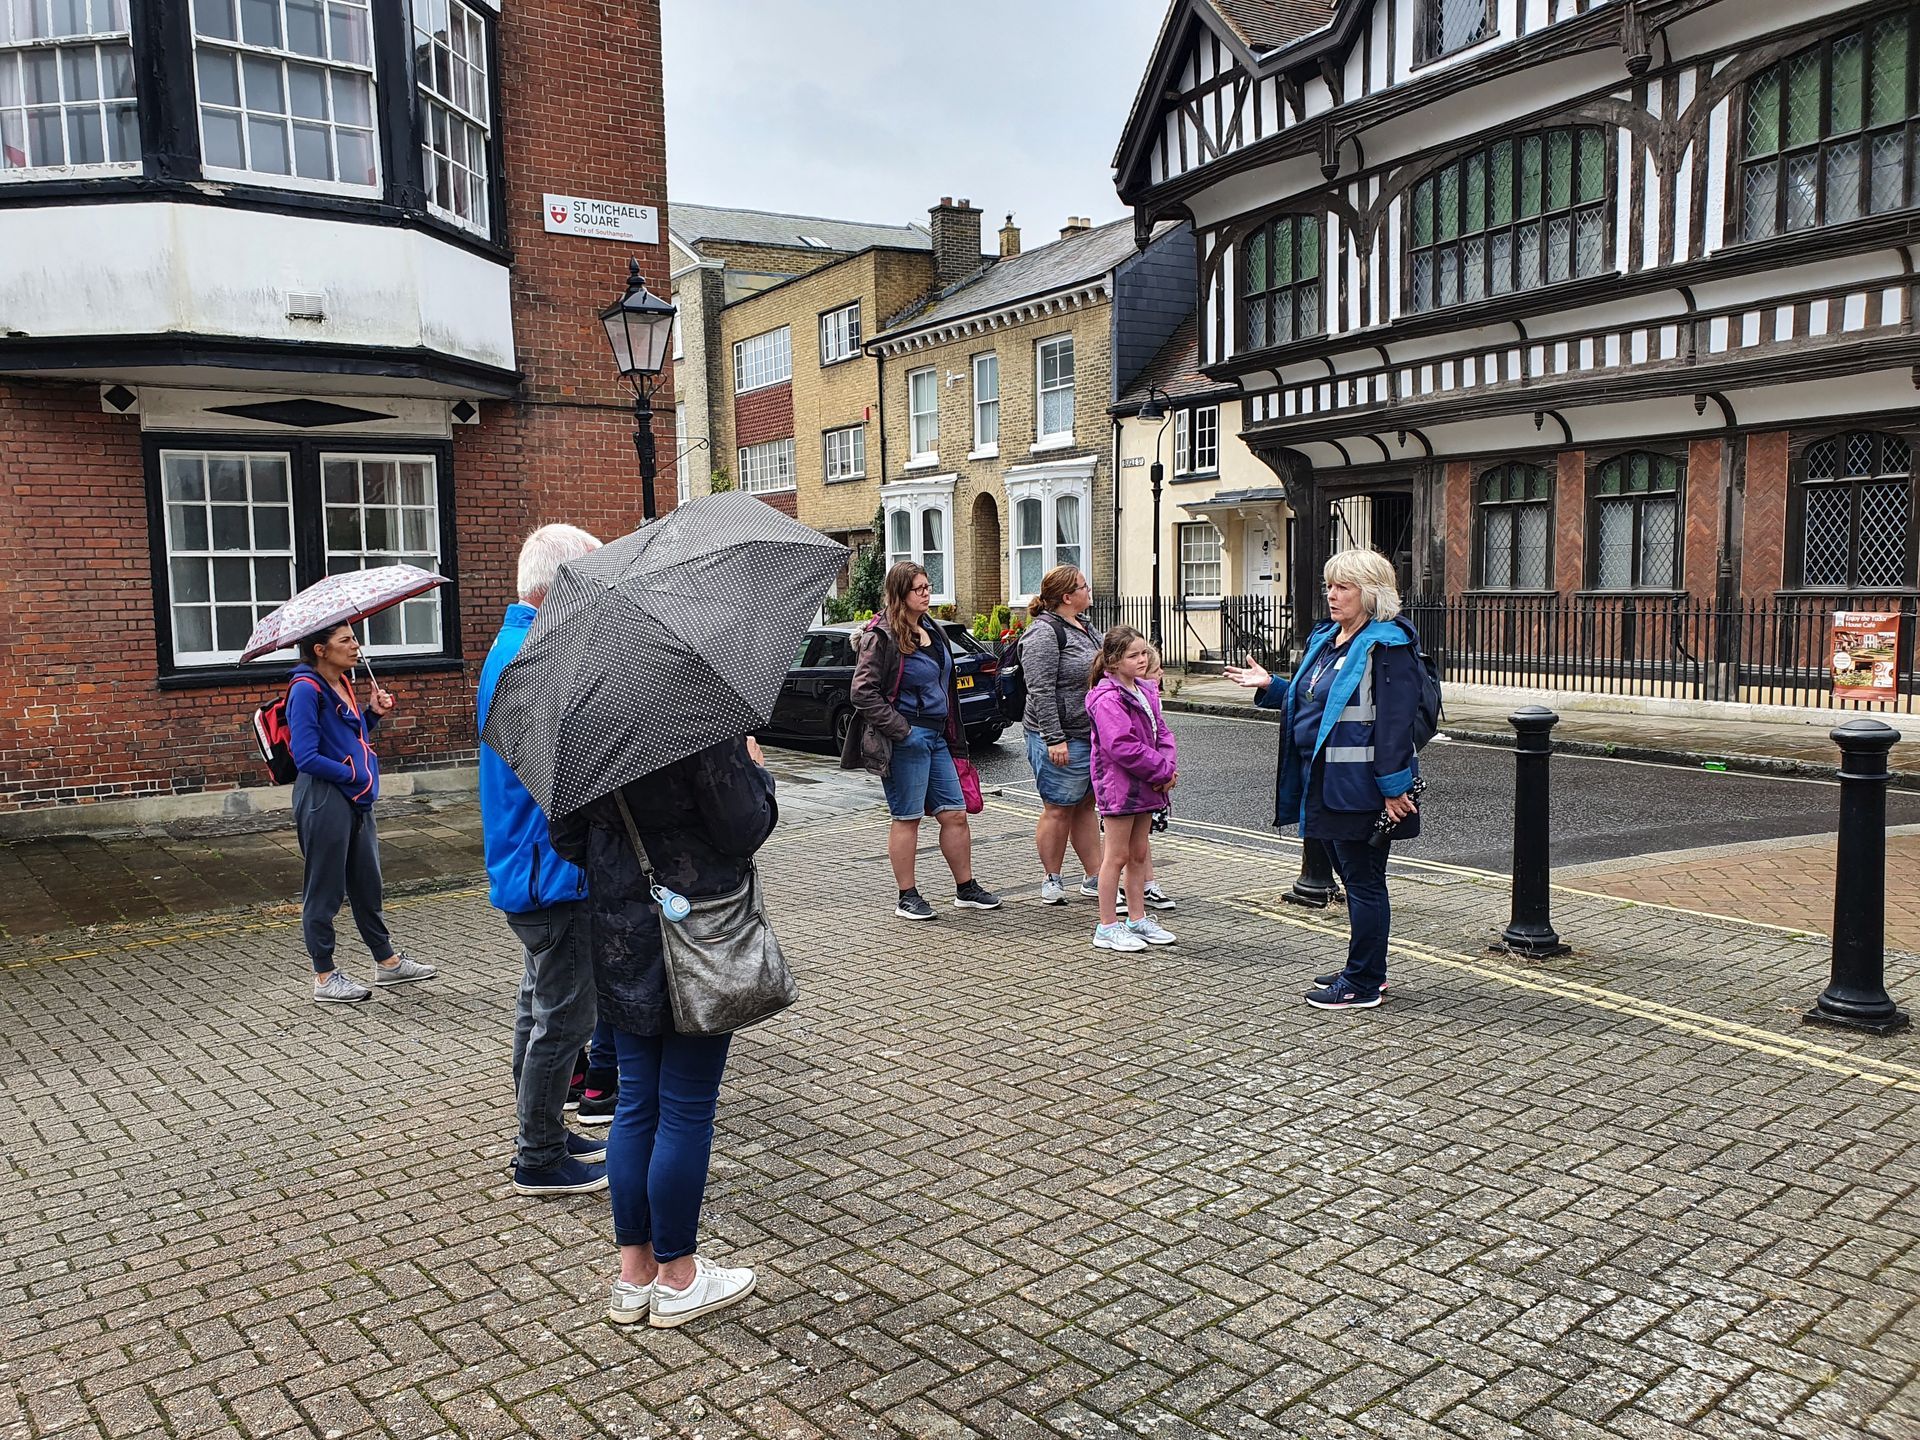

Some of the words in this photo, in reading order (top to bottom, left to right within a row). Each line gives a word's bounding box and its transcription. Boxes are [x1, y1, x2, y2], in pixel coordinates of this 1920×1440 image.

[574, 201, 587, 212] ST
[592, 203, 648, 220] MICHAELS
[574, 214, 620, 228] SQUARE
[596, 229, 633, 238] Southampton
